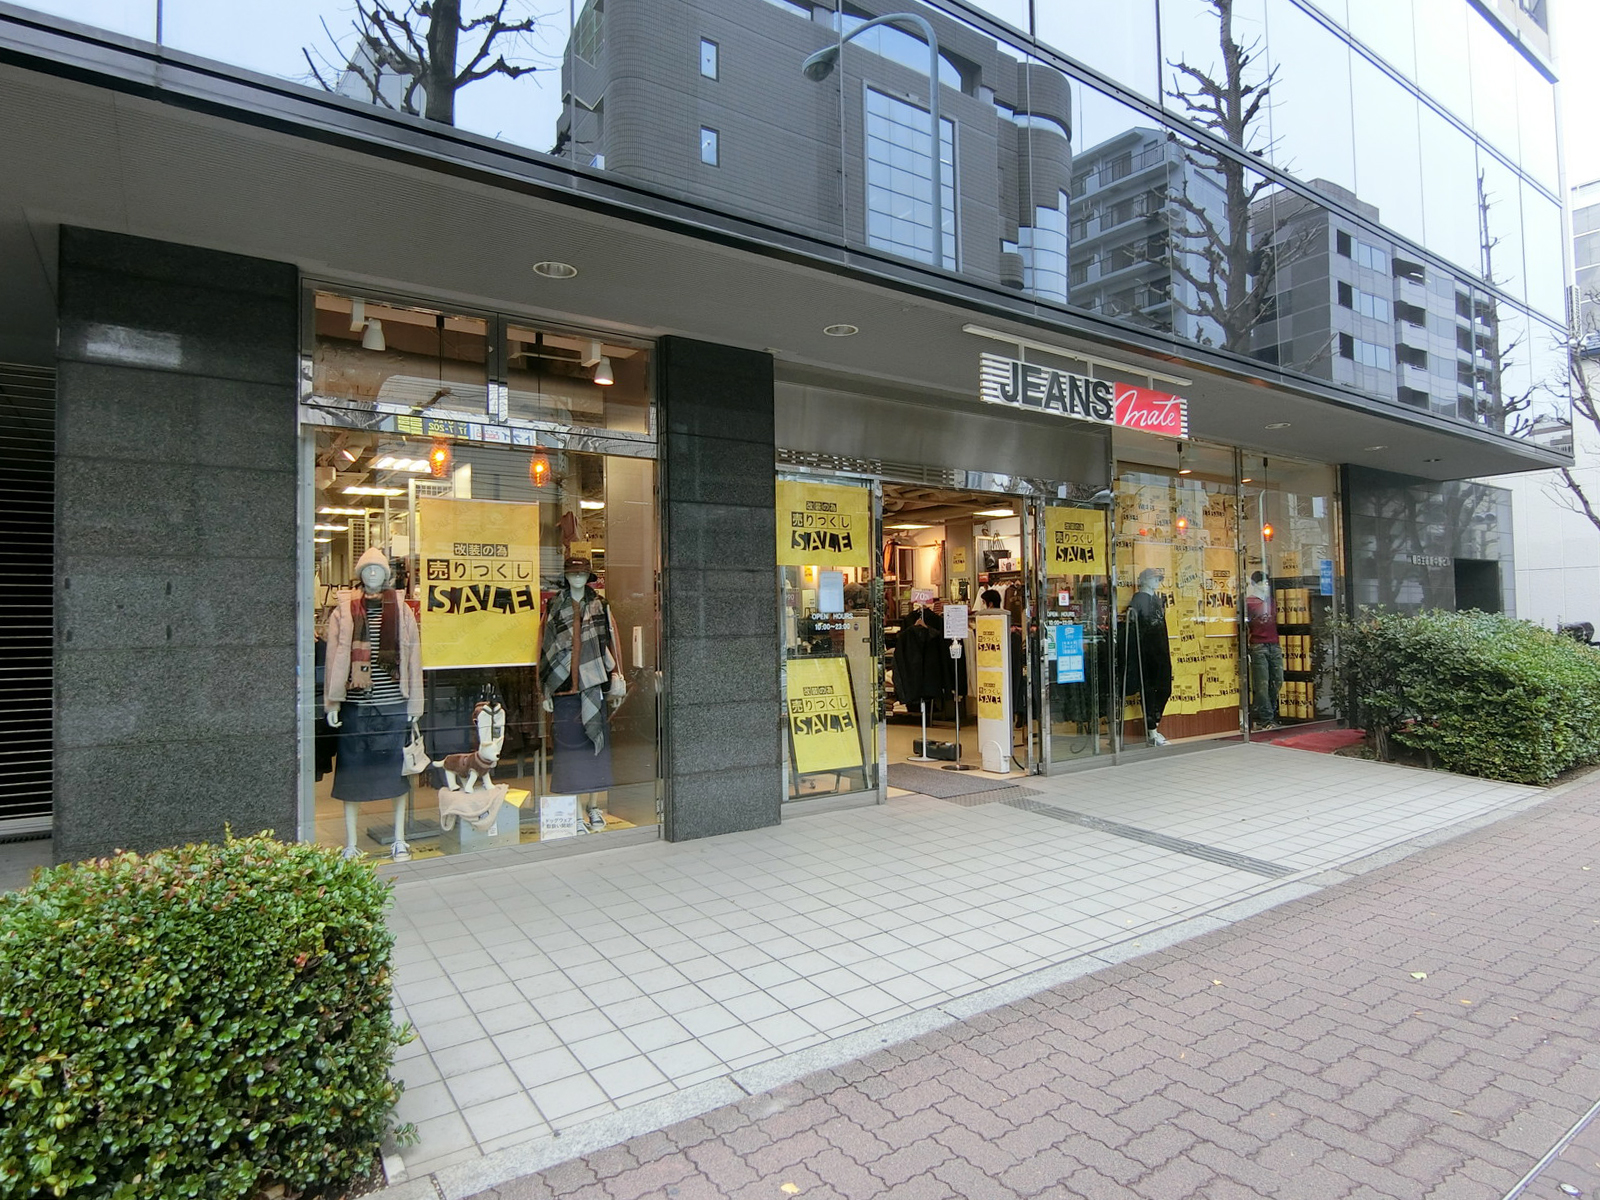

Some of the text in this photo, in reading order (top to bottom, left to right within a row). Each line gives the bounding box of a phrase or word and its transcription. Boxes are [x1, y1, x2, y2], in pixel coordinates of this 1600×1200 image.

[998, 361, 1112, 421] JEANS
[792, 512, 850, 528] 売りつくし
[454, 543, 508, 557] 改装の為
[792, 531, 852, 552] SALE
[1056, 546, 1094, 563] SALE
[428, 559, 532, 580] 売りつくし
[429, 585, 535, 615] SALE
[790, 696, 849, 713] 売りつくし
[794, 711, 854, 735] SALE
